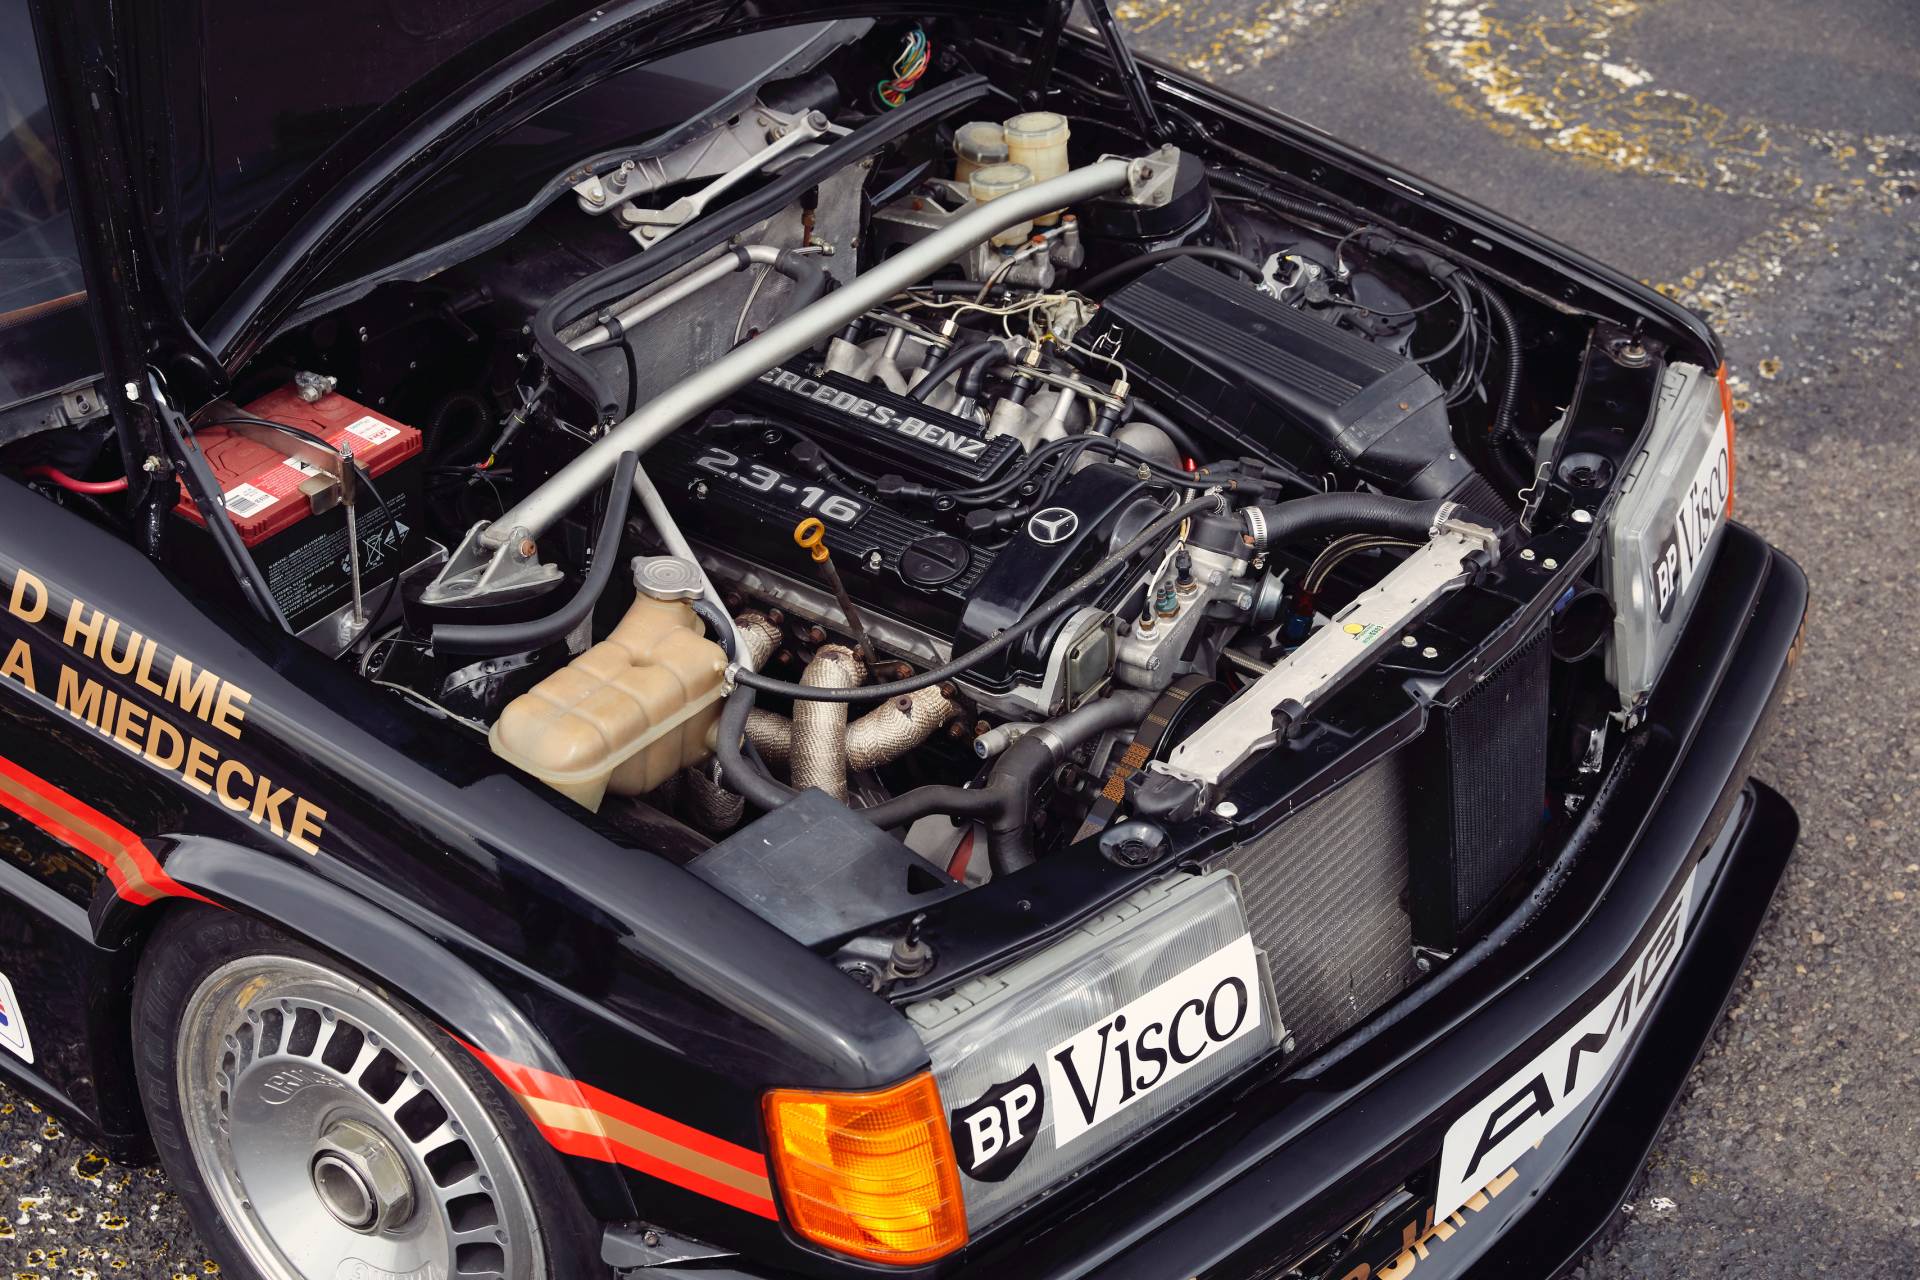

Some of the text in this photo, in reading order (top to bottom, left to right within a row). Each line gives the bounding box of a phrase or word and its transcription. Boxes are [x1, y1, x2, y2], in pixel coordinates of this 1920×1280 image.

[696, 448, 861, 522] 2.3-16
[759, 366, 987, 459] ERCEDES-BENZ
[1656, 447, 1728, 615] BP Visco
[8, 568, 252, 740] D HULME
[0, 638, 328, 856] A MIEDECKE
[963, 976, 1249, 1171] BP Visco
[1461, 895, 1684, 1184] AMG
